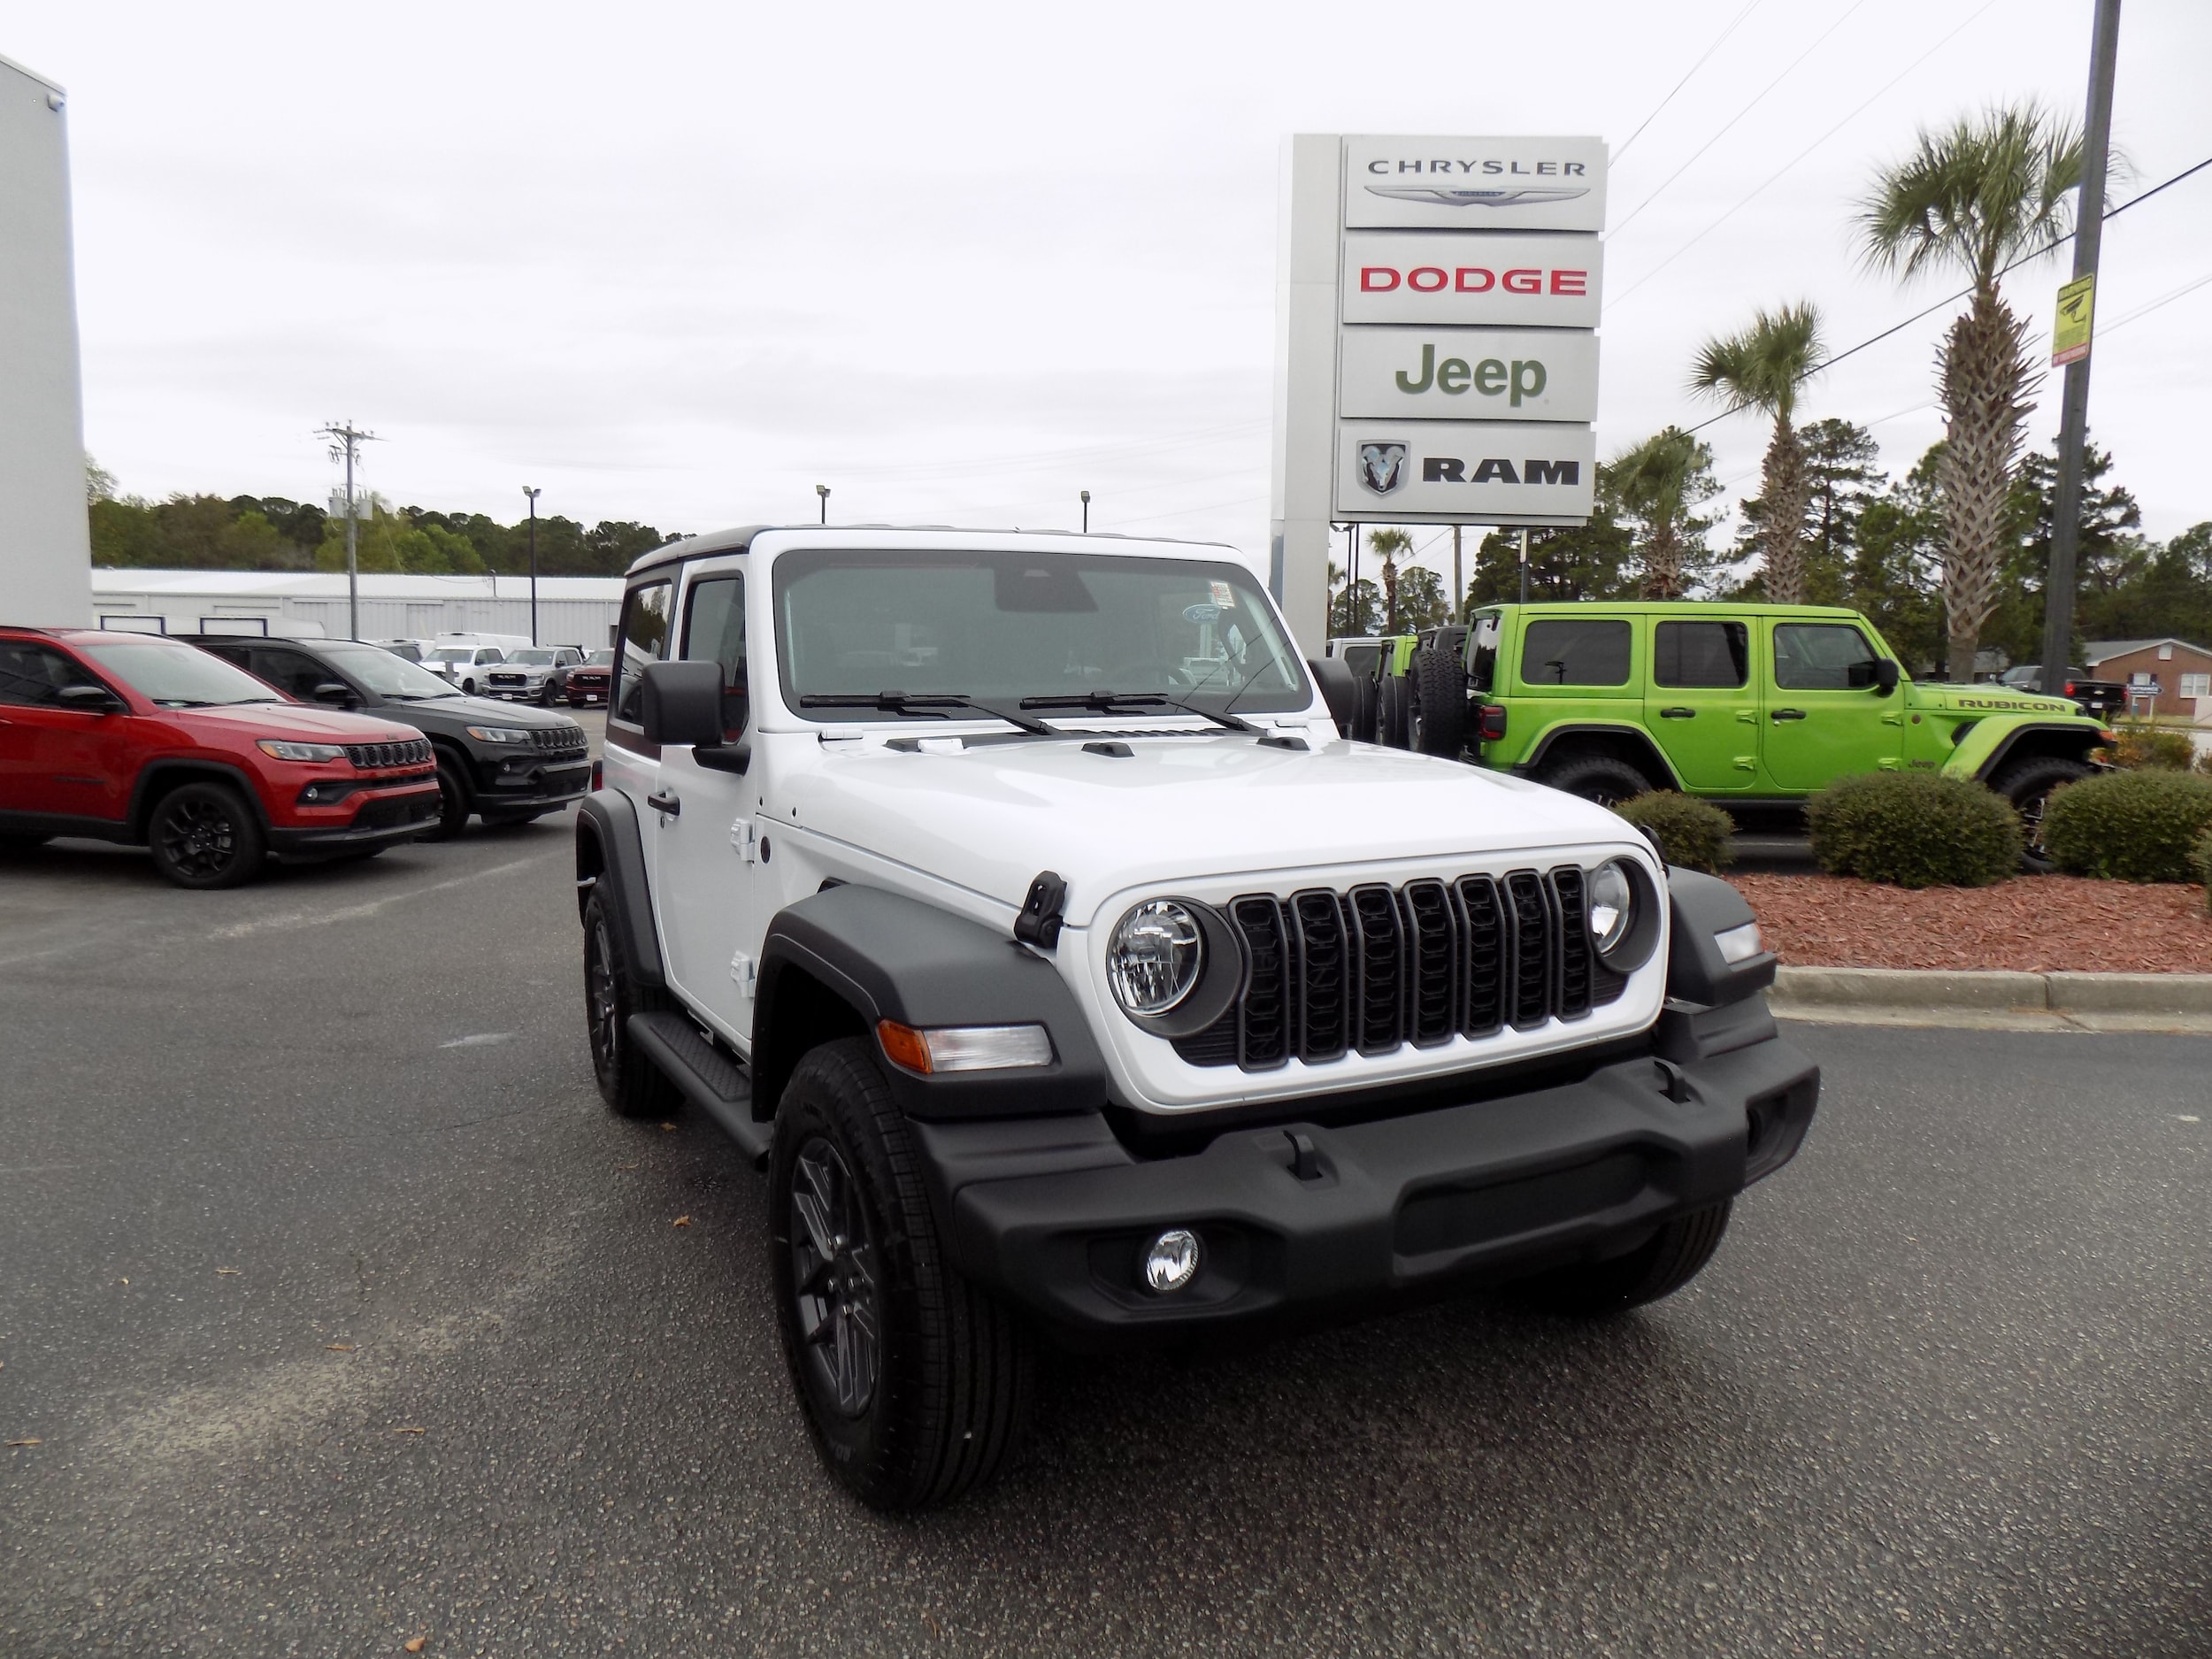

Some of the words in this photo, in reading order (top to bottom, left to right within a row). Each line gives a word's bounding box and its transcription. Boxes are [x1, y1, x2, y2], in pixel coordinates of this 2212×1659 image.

[1368, 159, 1586, 177] CHRYSLER
[1360, 266, 1587, 296] DODGE
[1395, 343, 1547, 407] Jeep
[1422, 457, 1579, 486] RAM
[1193, 608, 1220, 620] Ford
[1958, 699, 2066, 712] RUBICON
